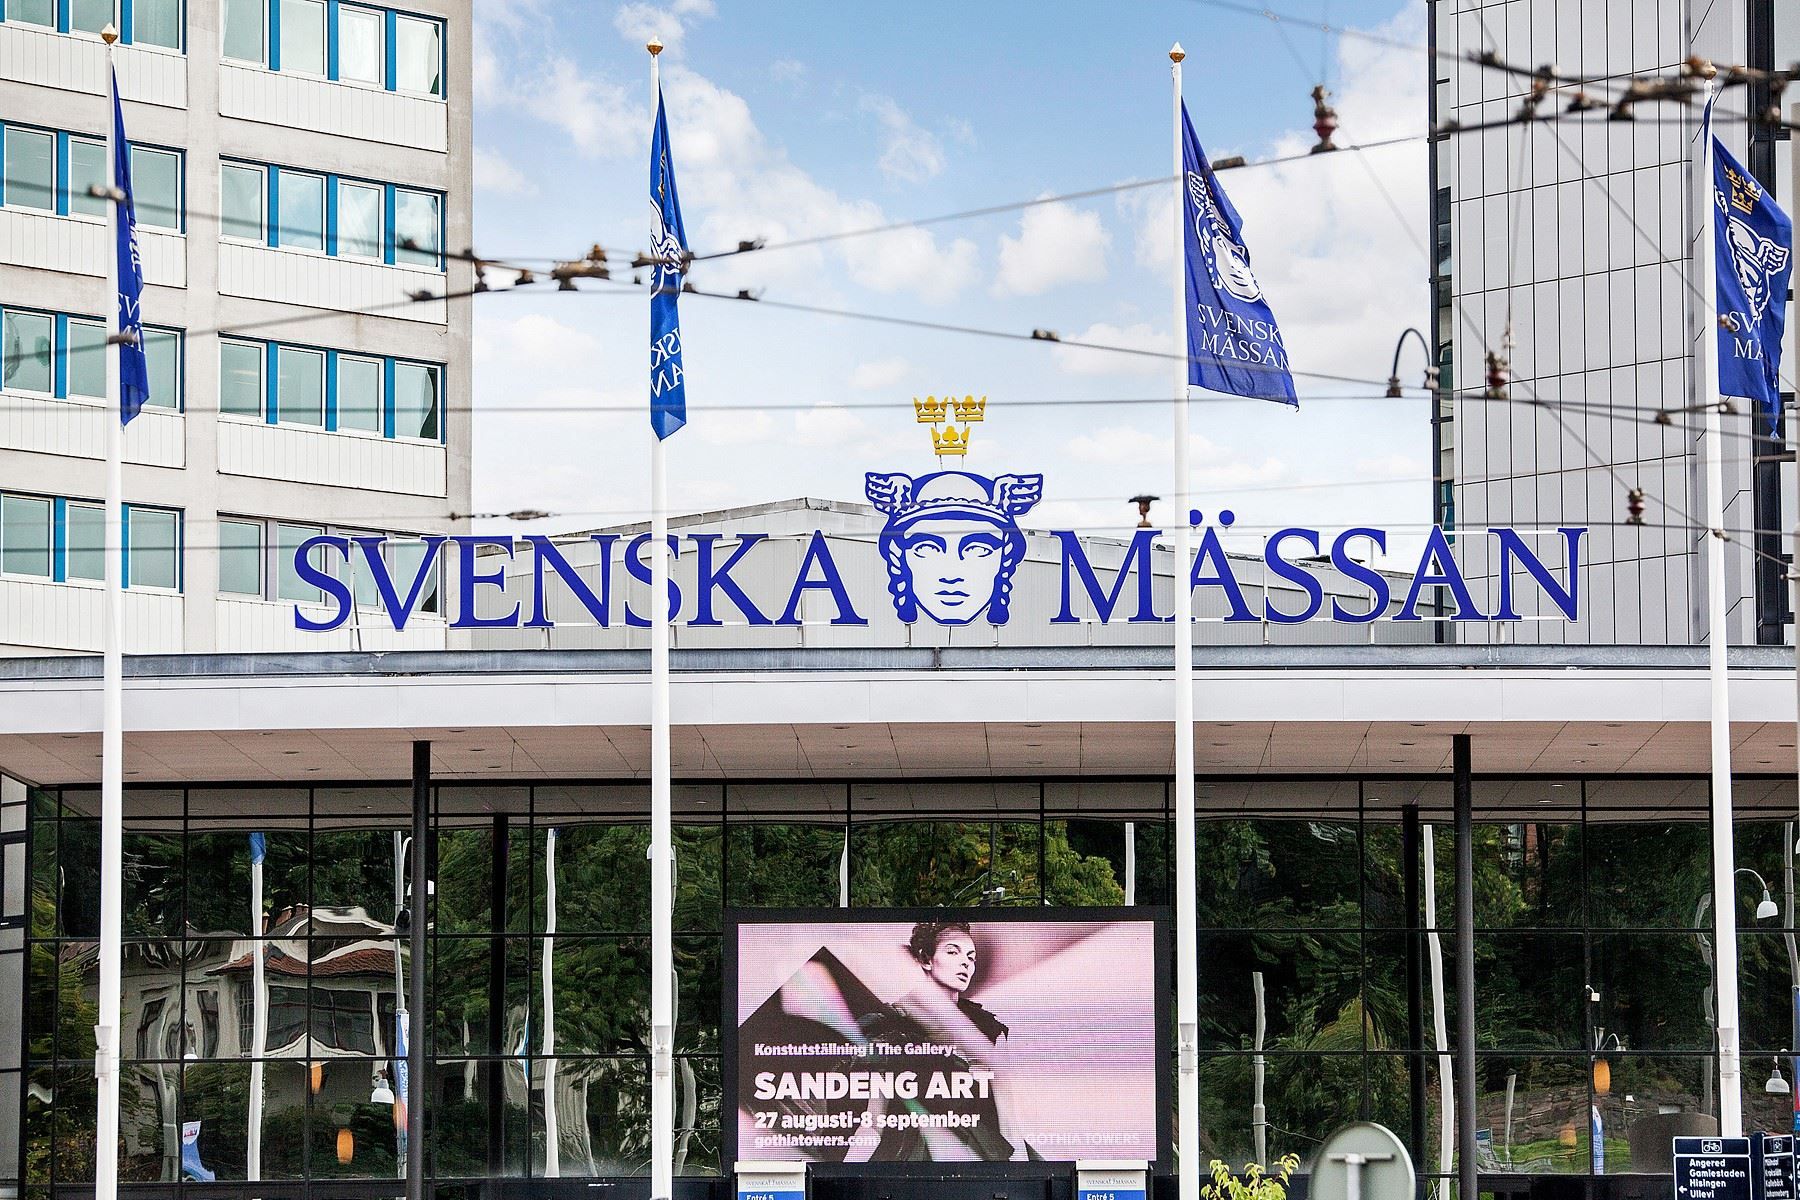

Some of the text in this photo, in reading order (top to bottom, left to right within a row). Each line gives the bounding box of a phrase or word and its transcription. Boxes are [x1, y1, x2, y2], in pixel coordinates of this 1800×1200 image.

[1198, 303, 1284, 348] SVENSK
[293, 509, 1589, 632] SVENSKA MÄSSAN
[754, 1043, 867, 1057] Konstutställning
[876, 1043, 902, 1056] The
[754, 1071, 995, 1100] SANDENG ART
[754, 1111, 981, 1131] 27 augusti-8 september
[754, 1133, 881, 1148] gothiatowers.com
[1024, 1132, 1140, 1145] GOTHIA TOWERS
[1689, 1158, 1726, 1169] Angered
[1689, 1168, 1746, 1178] Gamlestaden
[1689, 1178, 1727, 1189] Hisingen
[1086, 1192, 1108, 1200] Entré
[1689, 1189, 1715, 1199] Ullevi
